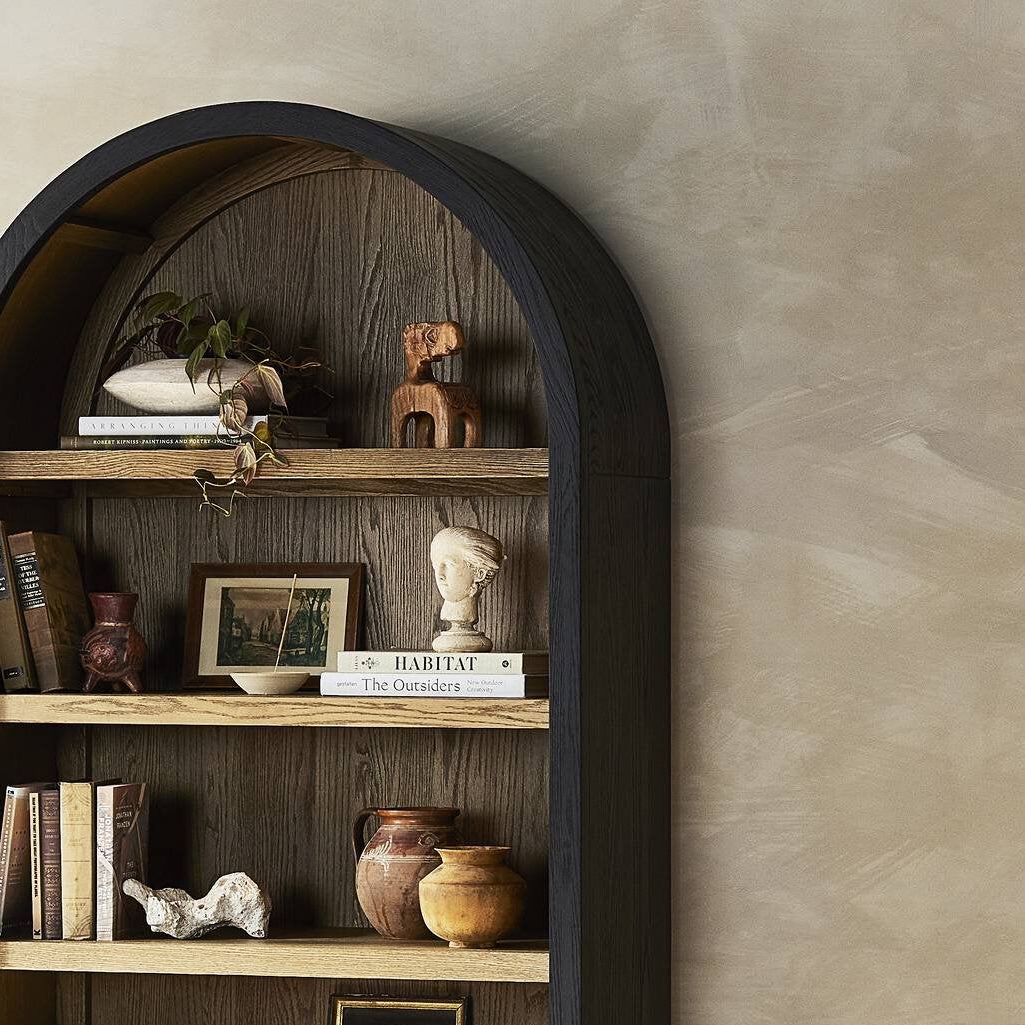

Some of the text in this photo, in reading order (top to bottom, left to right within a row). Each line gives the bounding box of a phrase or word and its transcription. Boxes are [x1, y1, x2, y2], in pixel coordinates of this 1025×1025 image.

[89, 422, 175, 430] ARRANGING
[395, 656, 478, 671] HABITAT
[361, 677, 389, 691] The
[393, 678, 461, 692] Outsiders
